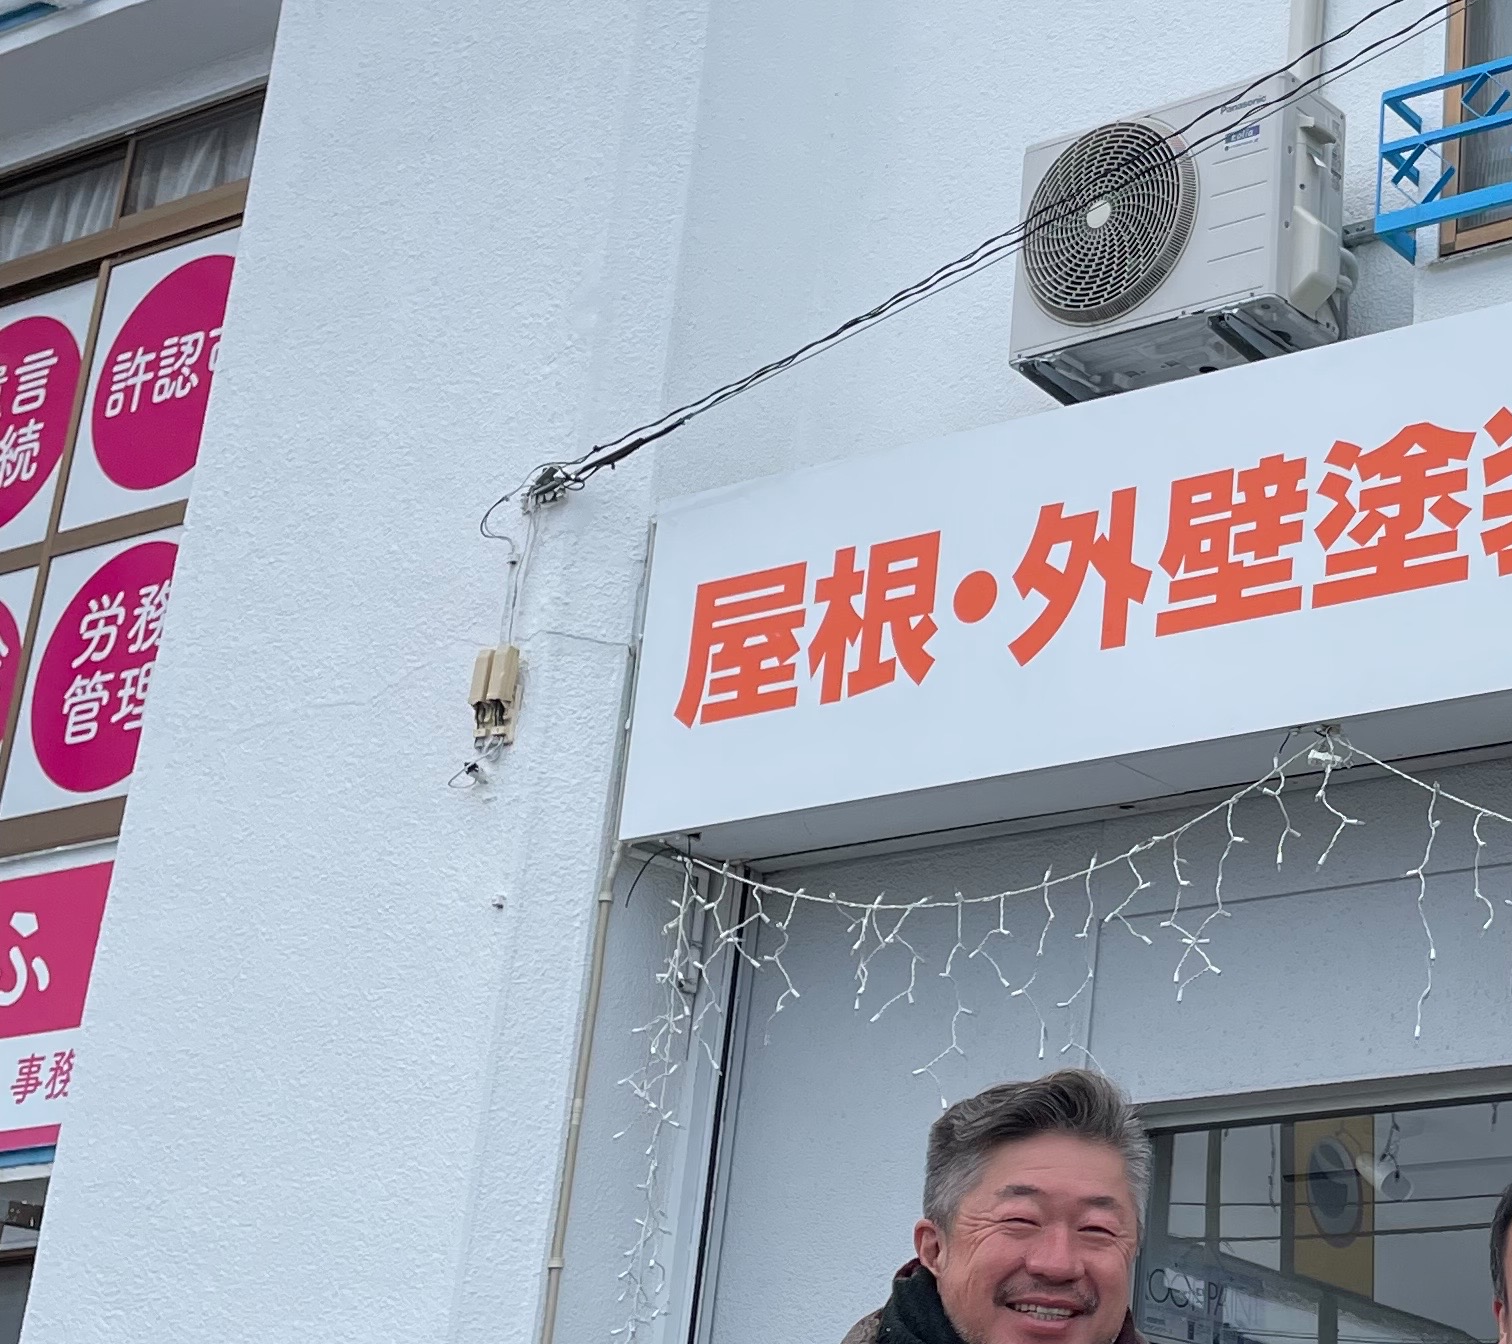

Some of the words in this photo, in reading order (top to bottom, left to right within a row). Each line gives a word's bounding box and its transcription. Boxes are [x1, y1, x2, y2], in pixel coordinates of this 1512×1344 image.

[1220, 95, 1267, 115] Panasonic
[71, 579, 171, 669] 労務
[62, 661, 155, 745] 管理
[10, 1049, 75, 1105] 事務
